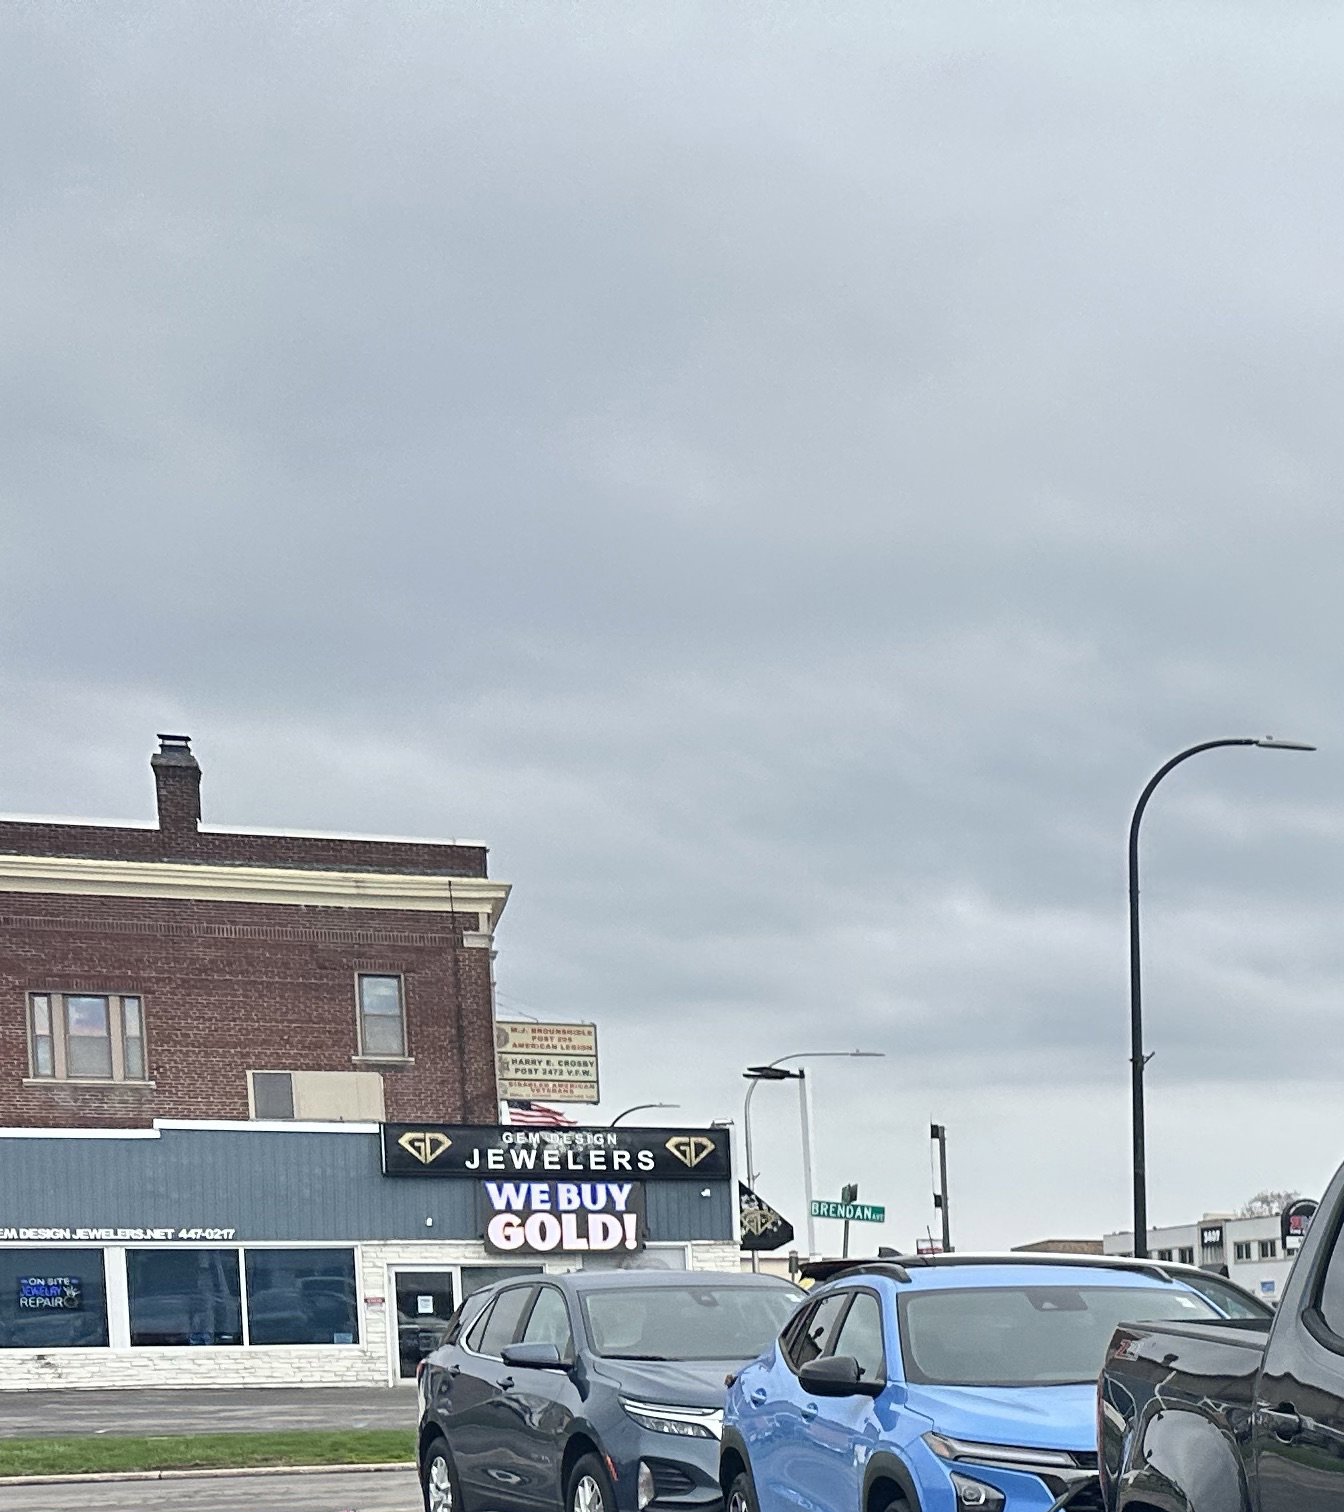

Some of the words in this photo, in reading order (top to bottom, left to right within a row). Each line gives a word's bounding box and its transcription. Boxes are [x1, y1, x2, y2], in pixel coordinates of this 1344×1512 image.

[512, 1042, 558, 1050] AMERICAN
[560, 1043, 593, 1051] LEGION
[511, 1058, 543, 1066] HARRY
[557, 1060, 595, 1068] CROSBY
[514, 1067, 540, 1075] POST
[502, 1131, 541, 1144] GEM
[549, 1132, 618, 1146] DESIGN
[465, 1148, 656, 1172] JEWELERS
[484, 1181, 551, 1211] WE
[556, 1182, 633, 1212] BUY
[811, 1201, 872, 1220] BRENDAN
[19, 1228, 71, 1240] DESIGN
[72, 1228, 175, 1240] JEWELERS.NET
[178, 1228, 236, 1240] 447-0217
[487, 1211, 638, 1252] GOLD!
[28, 1277, 45, 1286] ON
[47, 1277, 70, 1286] SITE
[19, 1296, 64, 1308] REPAIR
